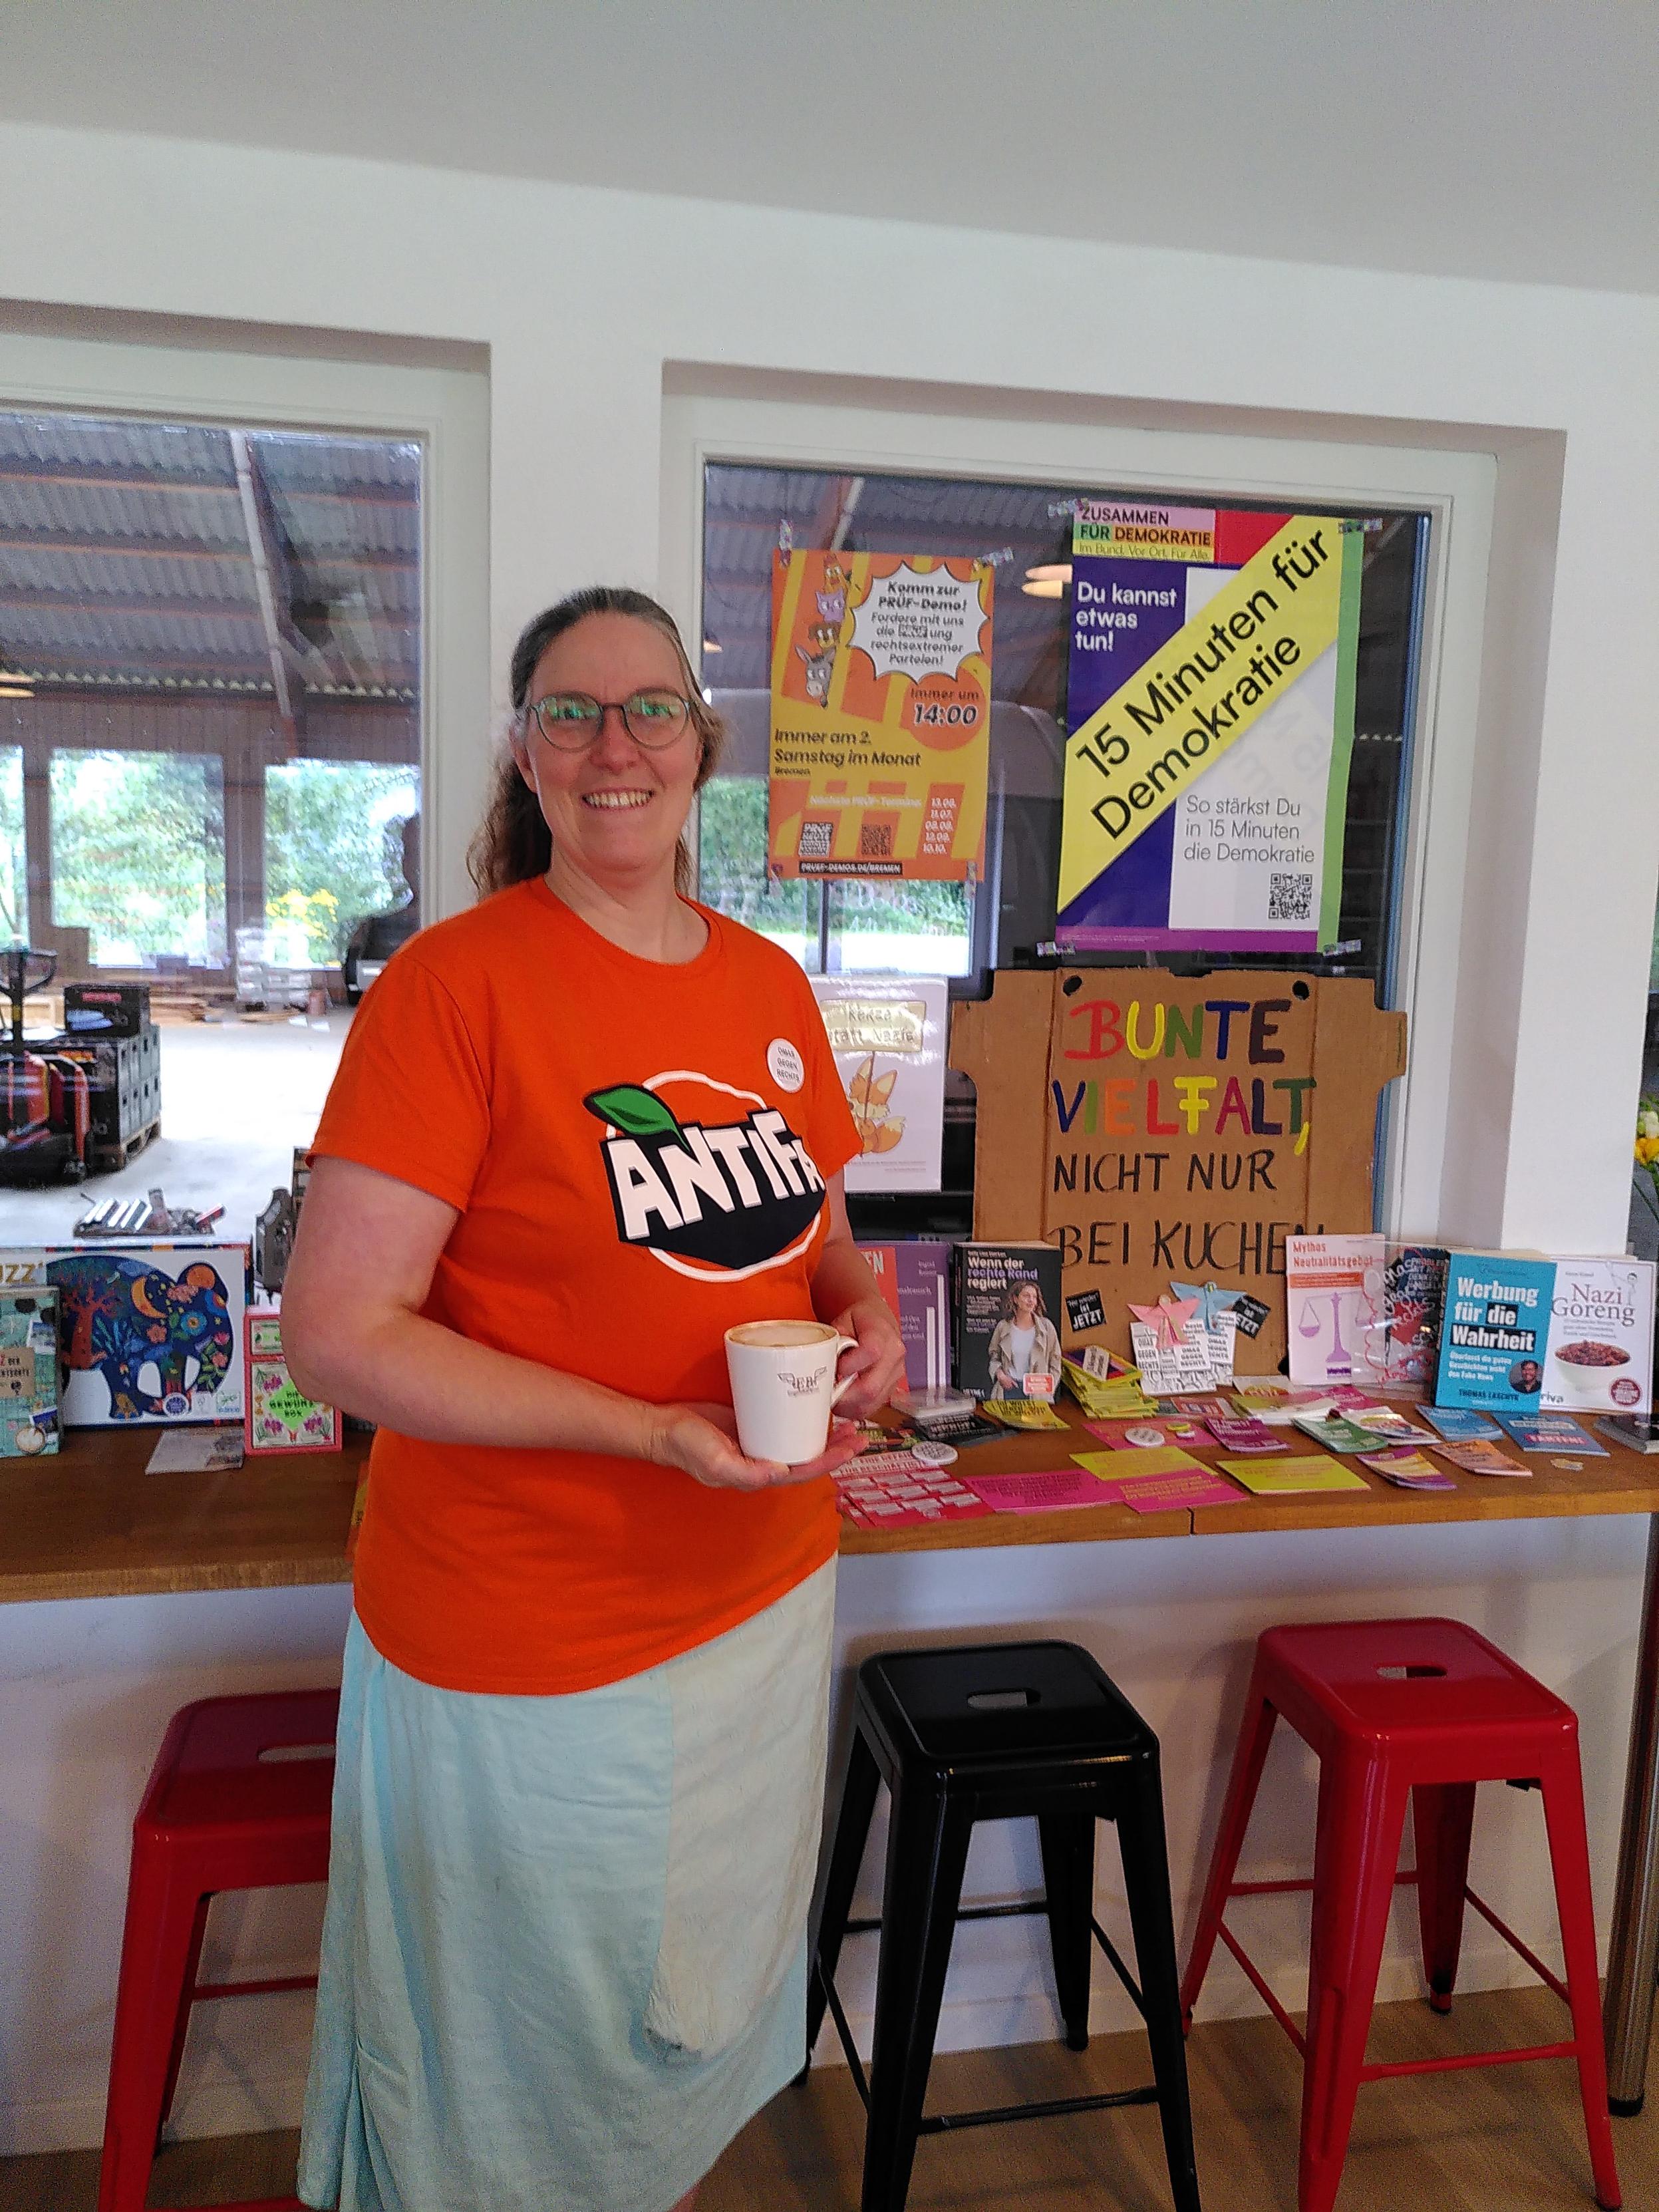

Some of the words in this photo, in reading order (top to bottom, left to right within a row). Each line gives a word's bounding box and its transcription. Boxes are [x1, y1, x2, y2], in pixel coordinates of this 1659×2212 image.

[1082, 507, 1169, 526] ZUSAMMEN
[1080, 522, 1110, 540] FÜR
[1115, 527, 1211, 546] DEMOKRATIE
[1079, 544, 1092, 553] Im
[1096, 543, 1124, 555] Bund.
[1128, 544, 1145, 555] Vor
[1149, 546, 1167, 557] Ort.
[1171, 546, 1186, 558] Für
[887, 581, 934, 595] Komm
[937, 585, 960, 596] zur
[1078, 581, 1106, 603] Du
[1112, 583, 1177, 607] kannst
[878, 593, 968, 612] PRÜF-Demo!
[871, 612, 917, 624] Fordere
[920, 613, 939, 625] mit
[943, 617, 965, 625] uns
[1076, 610, 1138, 629] etwas
[876, 626, 895, 637] die
[1075, 631, 1114, 652] tun!
[870, 639, 964, 653] rechtsextremer
[1076, 722, 1130, 779] 15
[1123, 588, 1279, 736] Minuten
[1271, 530, 1329, 593] für
[889, 653, 943, 666] Parteien!
[911, 687, 954, 700] Immer
[958, 691, 979, 701] um
[913, 703, 977, 726] 14:00
[774, 728, 825, 744] Immer
[830, 730, 857, 744] am
[859, 730, 871, 745] 2.
[1090, 634, 1300, 840] Demokratie
[774, 748, 845, 769] Samstag
[848, 750, 868, 764] im
[871, 752, 921, 767] Monat
[1186, 795, 1211, 814] So
[1216, 798, 1270, 816] stärkst
[1277, 798, 1301, 816] Du
[1185, 820, 1201, 837] in
[1209, 819, 1225, 837] 15
[1231, 820, 1300, 840] Minuten
[1183, 842, 1211, 860] die
[1217, 843, 1315, 863] Demokratie
[1064, 999, 1290, 1064] BUNTE
[777, 1068, 800, 1082] RECHTS
[1052, 1075, 1316, 1155] VIELFALT,
[607, 1109, 826, 1240] ANTIFA
[1053, 1152, 1169, 1193] NICHT
[1187, 1149, 1277, 1193] NUR
[1048, 1221, 1130, 1269] BEI
[1152, 1219, 1324, 1275] KUCHE
[1292, 1241, 1326, 1255] Mythos
[968, 1257, 1002, 1269] Wenn
[1003, 1257, 1024, 1269] der
[967, 1268, 1006, 1278] rechte
[1008, 1268, 1038, 1281] Rand
[967, 1278, 1008, 1292] regiert
[1457, 1277, 1539, 1307] Werbung
[1571, 1283, 1622, 1304] Nazi
[1073, 1309, 1102, 1329] JETZT
[1455, 1301, 1482, 1323] für
[1487, 1305, 1517, 1326] die
[1552, 1297, 1635, 1327] Goreng
[1237, 1313, 1259, 1335] ETZT
[1451, 1325, 1535, 1351] Wahrheit
